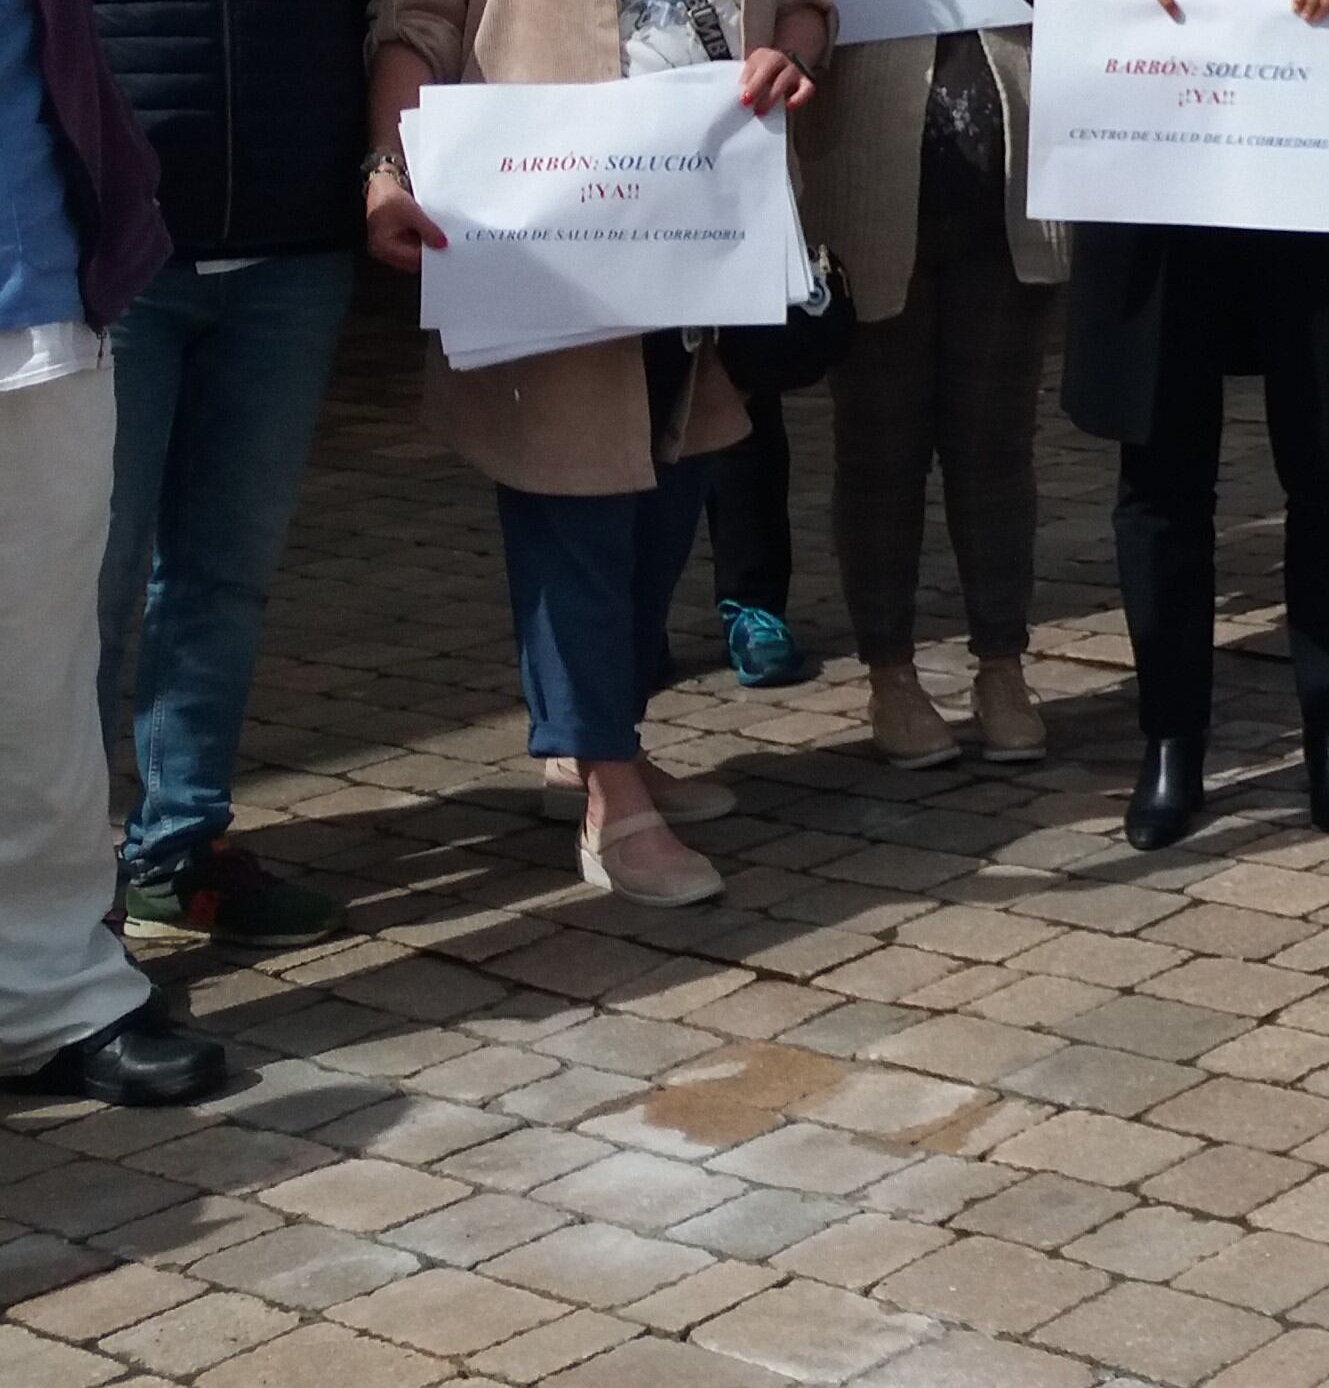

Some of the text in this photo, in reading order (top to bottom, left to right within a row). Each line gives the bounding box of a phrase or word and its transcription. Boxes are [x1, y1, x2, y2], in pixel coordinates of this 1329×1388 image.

[1104, 56, 1310, 81] BARBÓN: SOLUCIÓN
[1069, 128, 1127, 141] CENTRO
[1131, 129, 1150, 141] DE
[1153, 130, 1200, 143] SALUD
[1203, 132, 1221, 144] DE
[1225, 134, 1244, 145] LA
[500, 150, 716, 172] BARBÓN: SOLUCIÓN
[465, 229, 746, 242] CENTRO DE SALUD DE LA CORREDORIA
